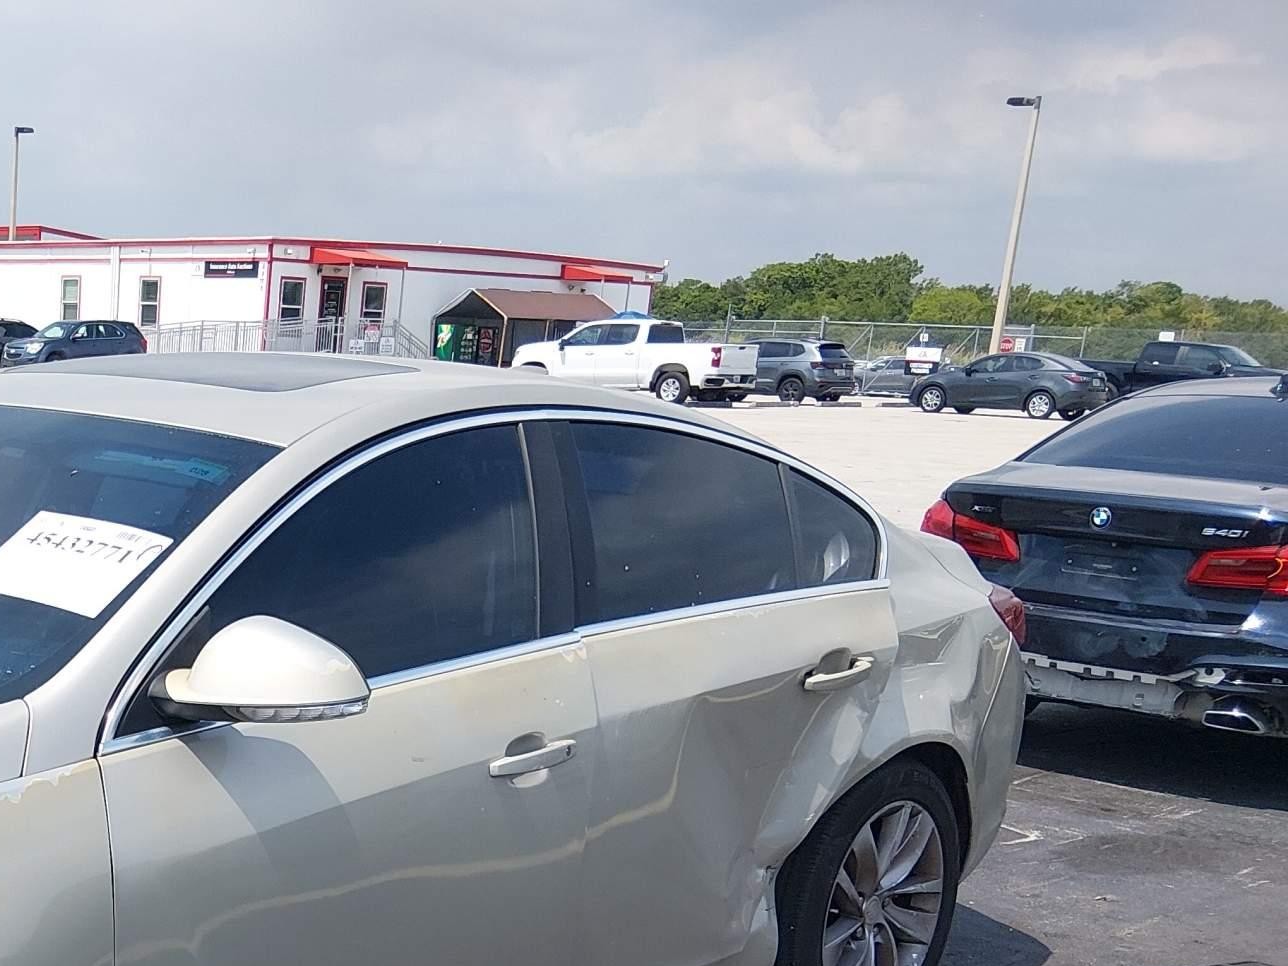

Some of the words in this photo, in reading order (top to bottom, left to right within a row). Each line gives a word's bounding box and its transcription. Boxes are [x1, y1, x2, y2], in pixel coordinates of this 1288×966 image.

[1000, 342, 1013, 350] STOP
[1200, 527, 1250, 539] 540i
[26, 531, 133, 563] 45432771
